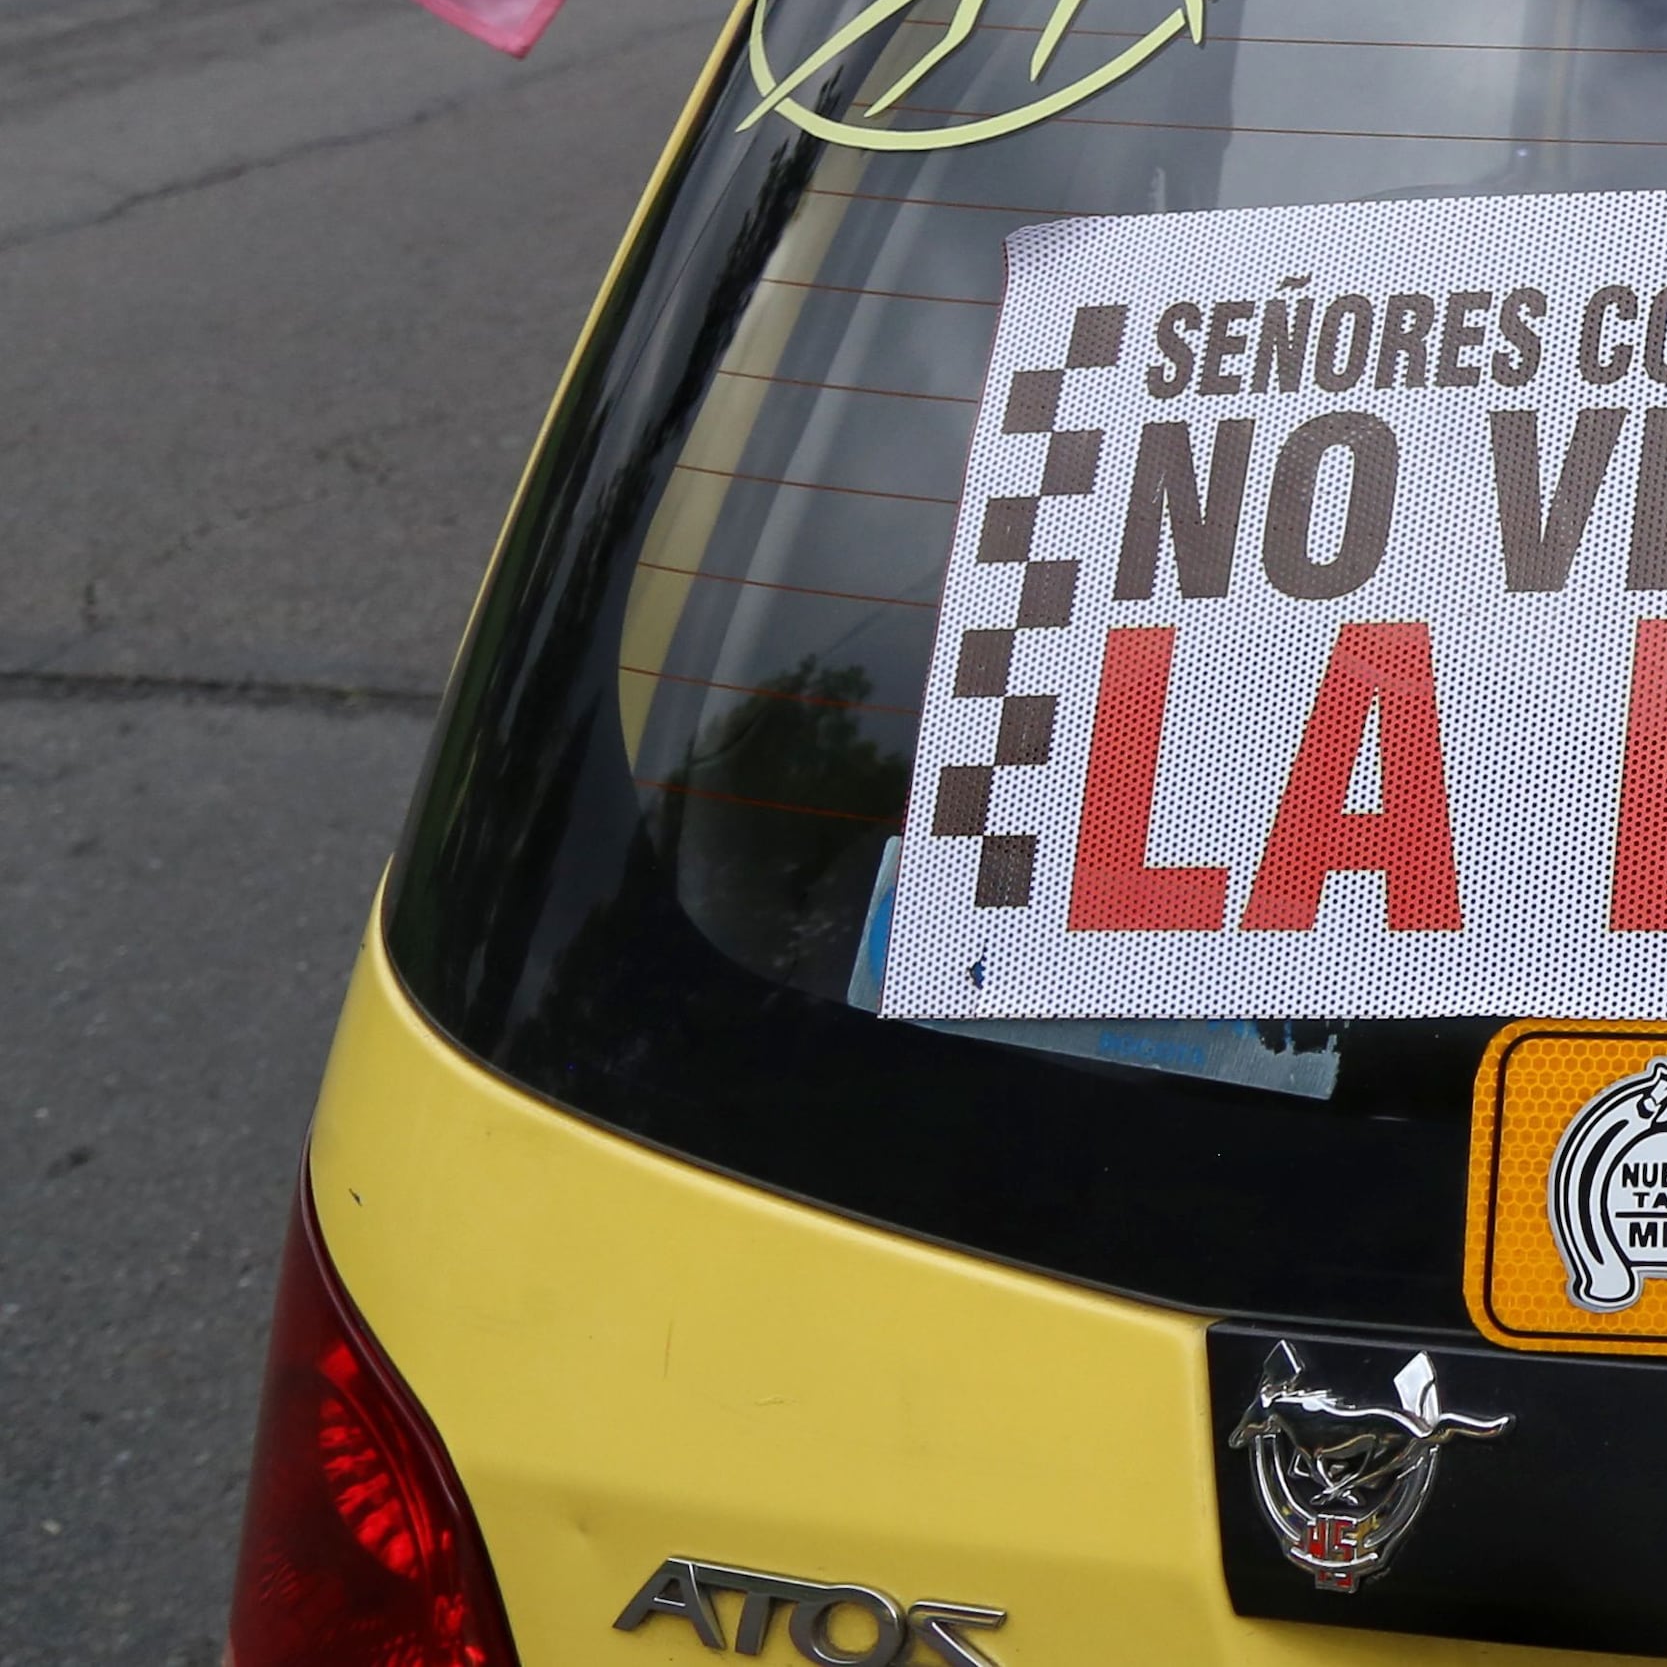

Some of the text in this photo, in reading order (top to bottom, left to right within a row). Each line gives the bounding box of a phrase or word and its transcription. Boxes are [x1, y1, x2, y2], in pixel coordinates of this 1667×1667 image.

[1147, 273, 1547, 400] SEÑORES
[1112, 411, 1401, 601] NO
[1068, 620, 1464, 933] LA
